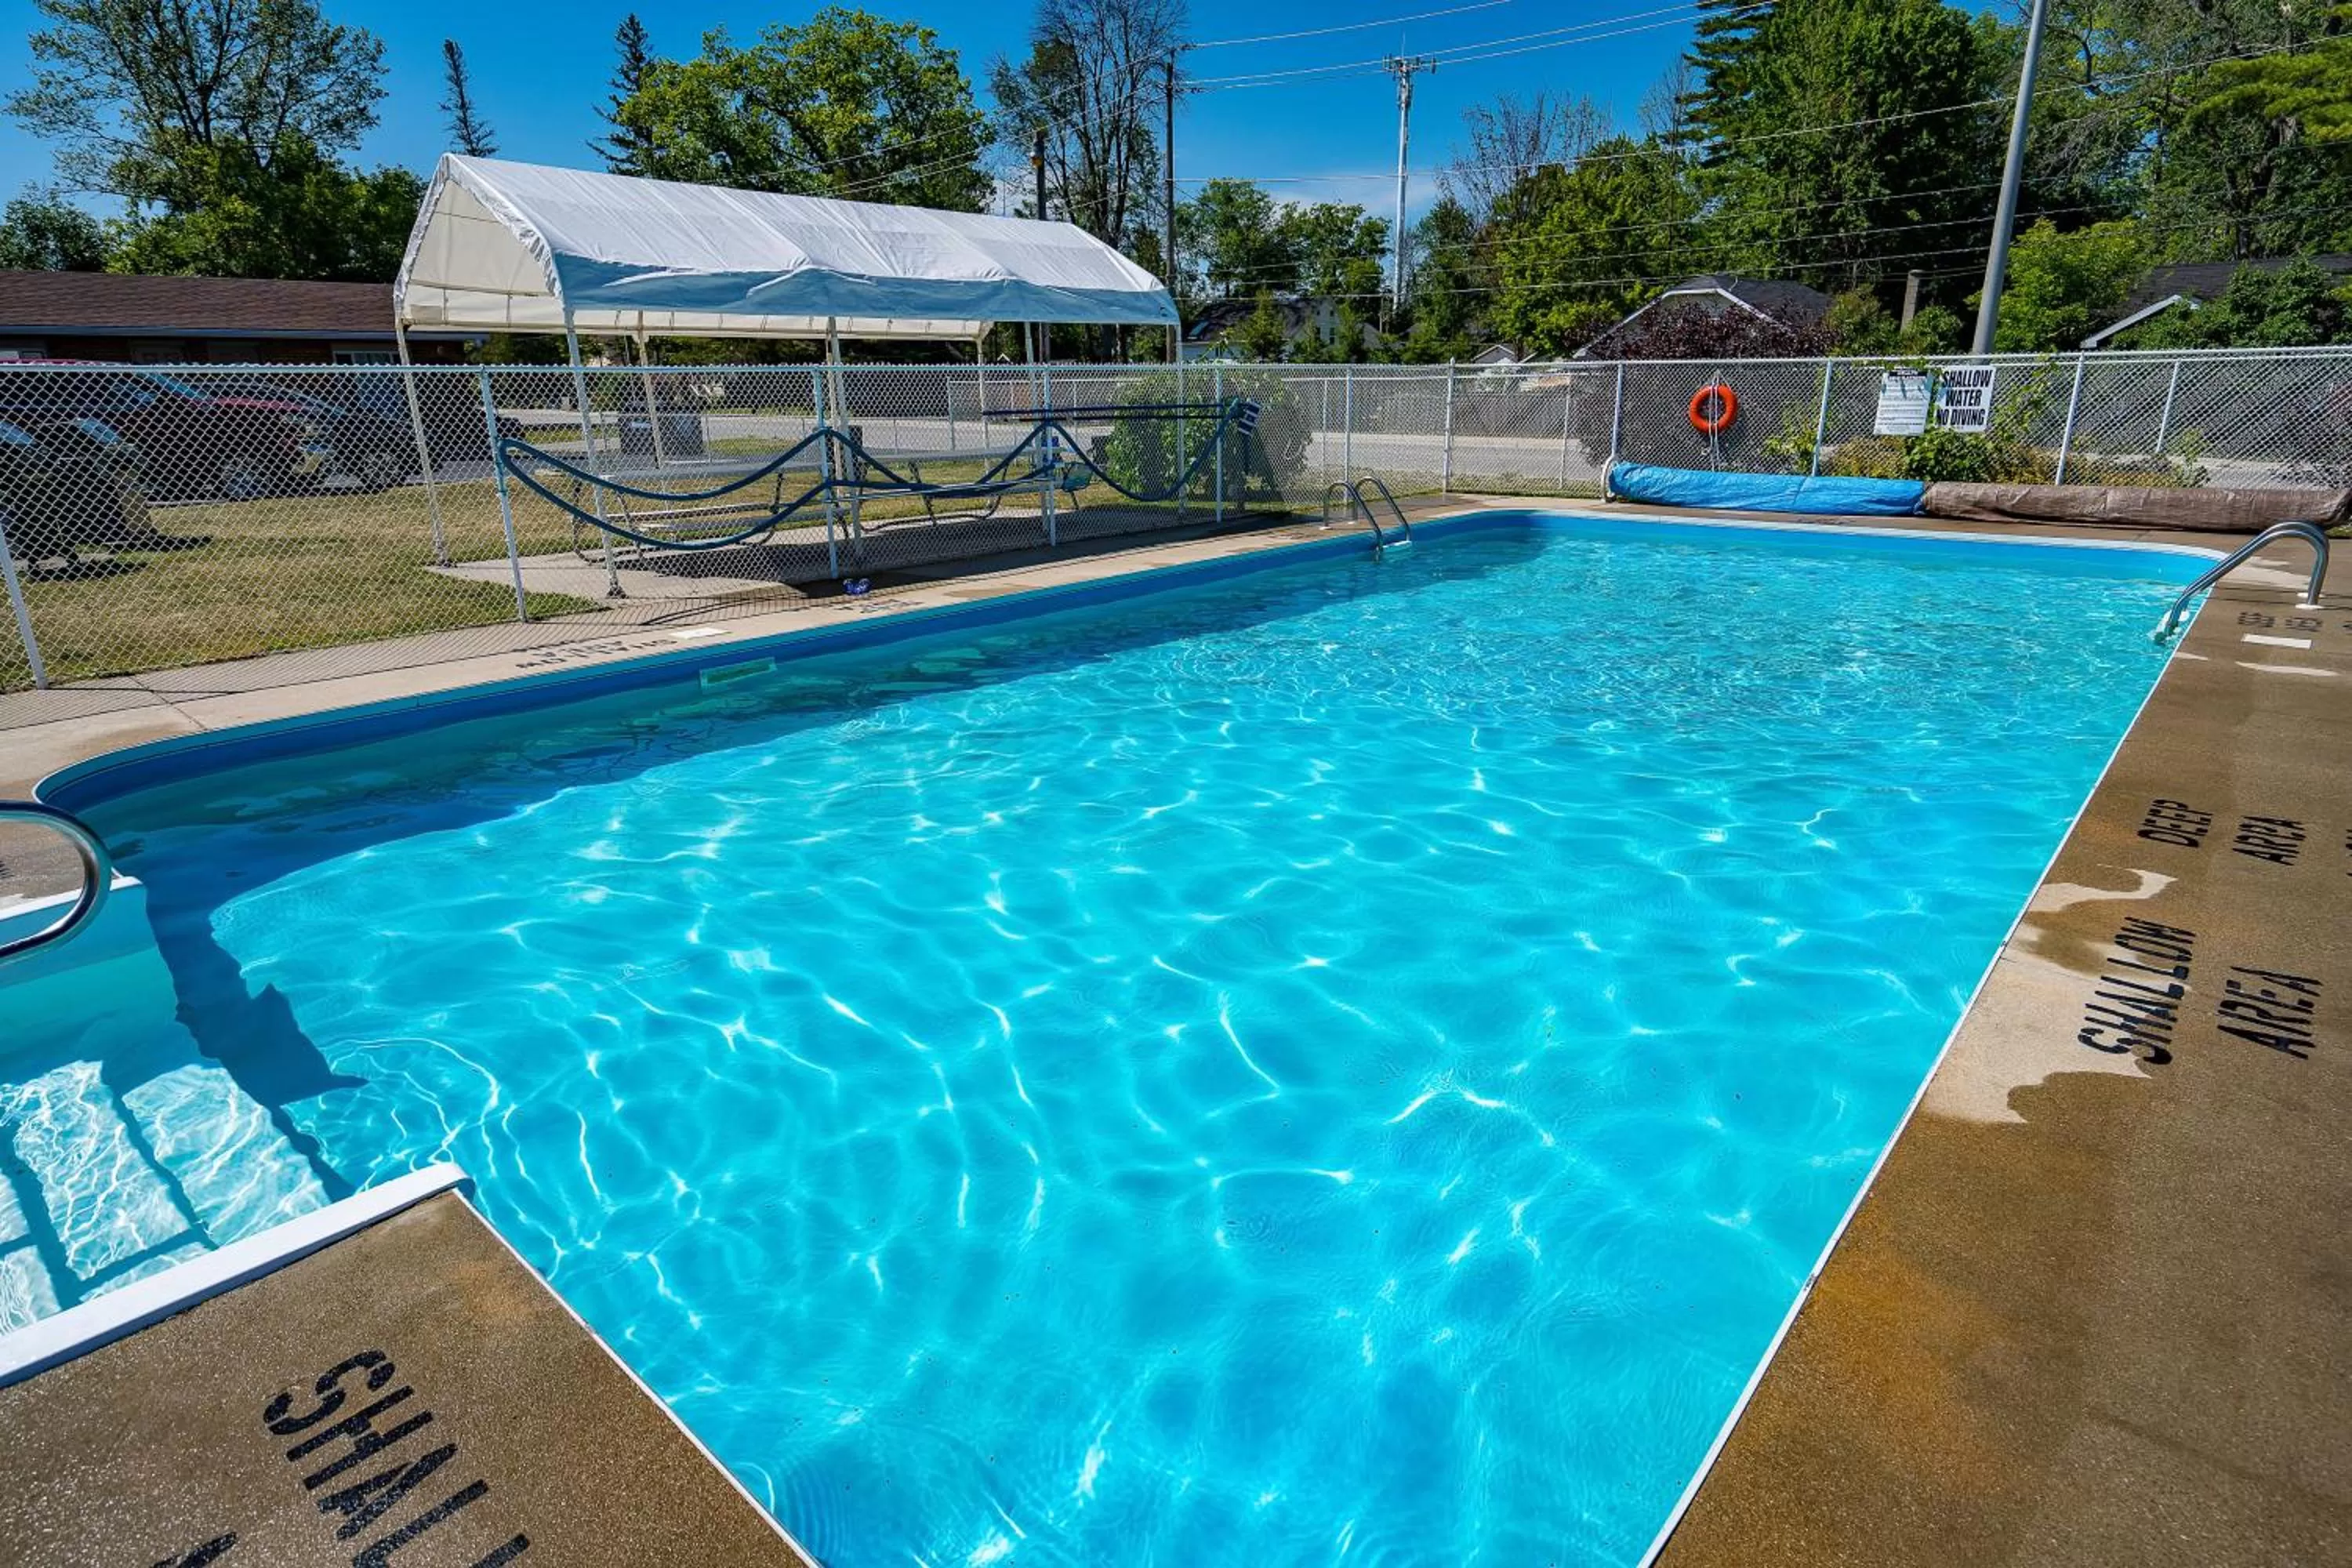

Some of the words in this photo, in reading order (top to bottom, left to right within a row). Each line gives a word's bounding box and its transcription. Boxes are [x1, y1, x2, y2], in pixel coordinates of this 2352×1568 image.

[1944, 370, 1992, 387] SHALLOW
[1946, 390, 1982, 406] WATER
[1936, 408, 1948, 425] NO
[1951, 408, 1985, 425] DIVING
[2137, 799, 2213, 848] DEEP
[2232, 815, 2307, 866] AREA
[2078, 916, 2196, 1065] SHALLOW
[2216, 966, 2323, 1059] AREA
